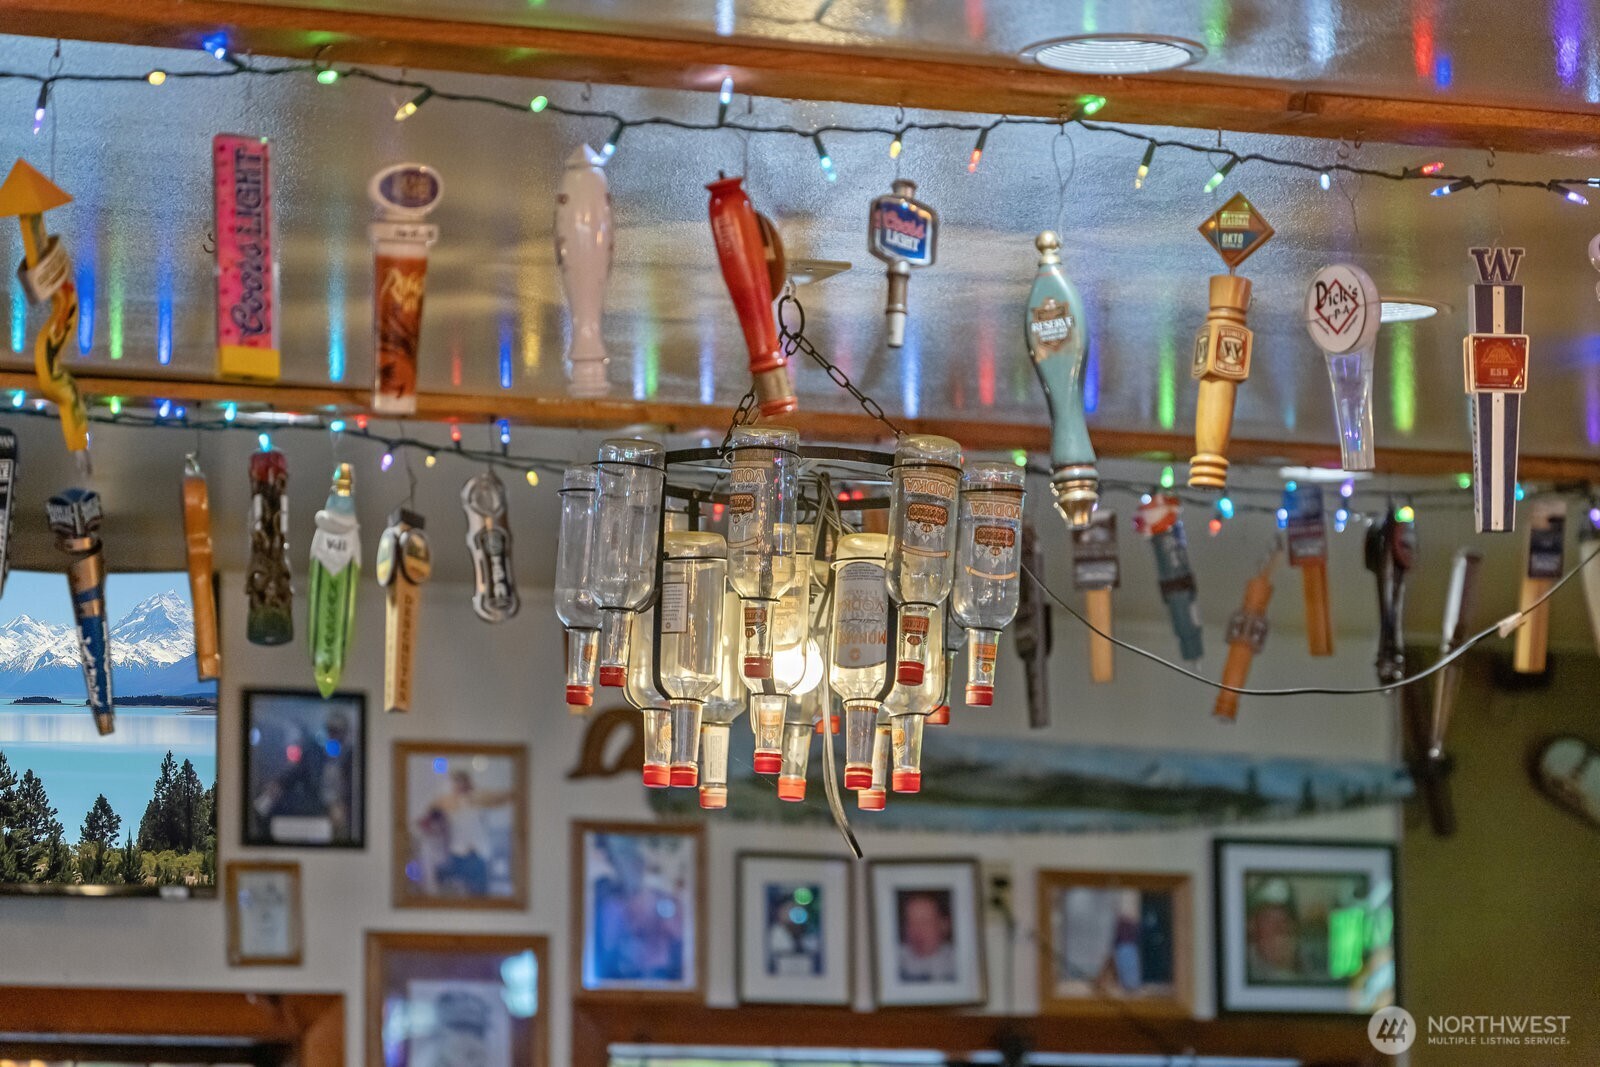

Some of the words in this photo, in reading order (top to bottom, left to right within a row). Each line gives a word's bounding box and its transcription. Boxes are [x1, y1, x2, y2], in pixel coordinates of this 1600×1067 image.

[234, 147, 263, 235] LIGHT
[1222, 232, 1244, 244] OKTO
[1468, 246, 1526, 284] W
[1315, 280, 1358, 310] Dick's
[903, 477, 956, 501] VODKA
[970, 501, 1021, 520] VODKA
